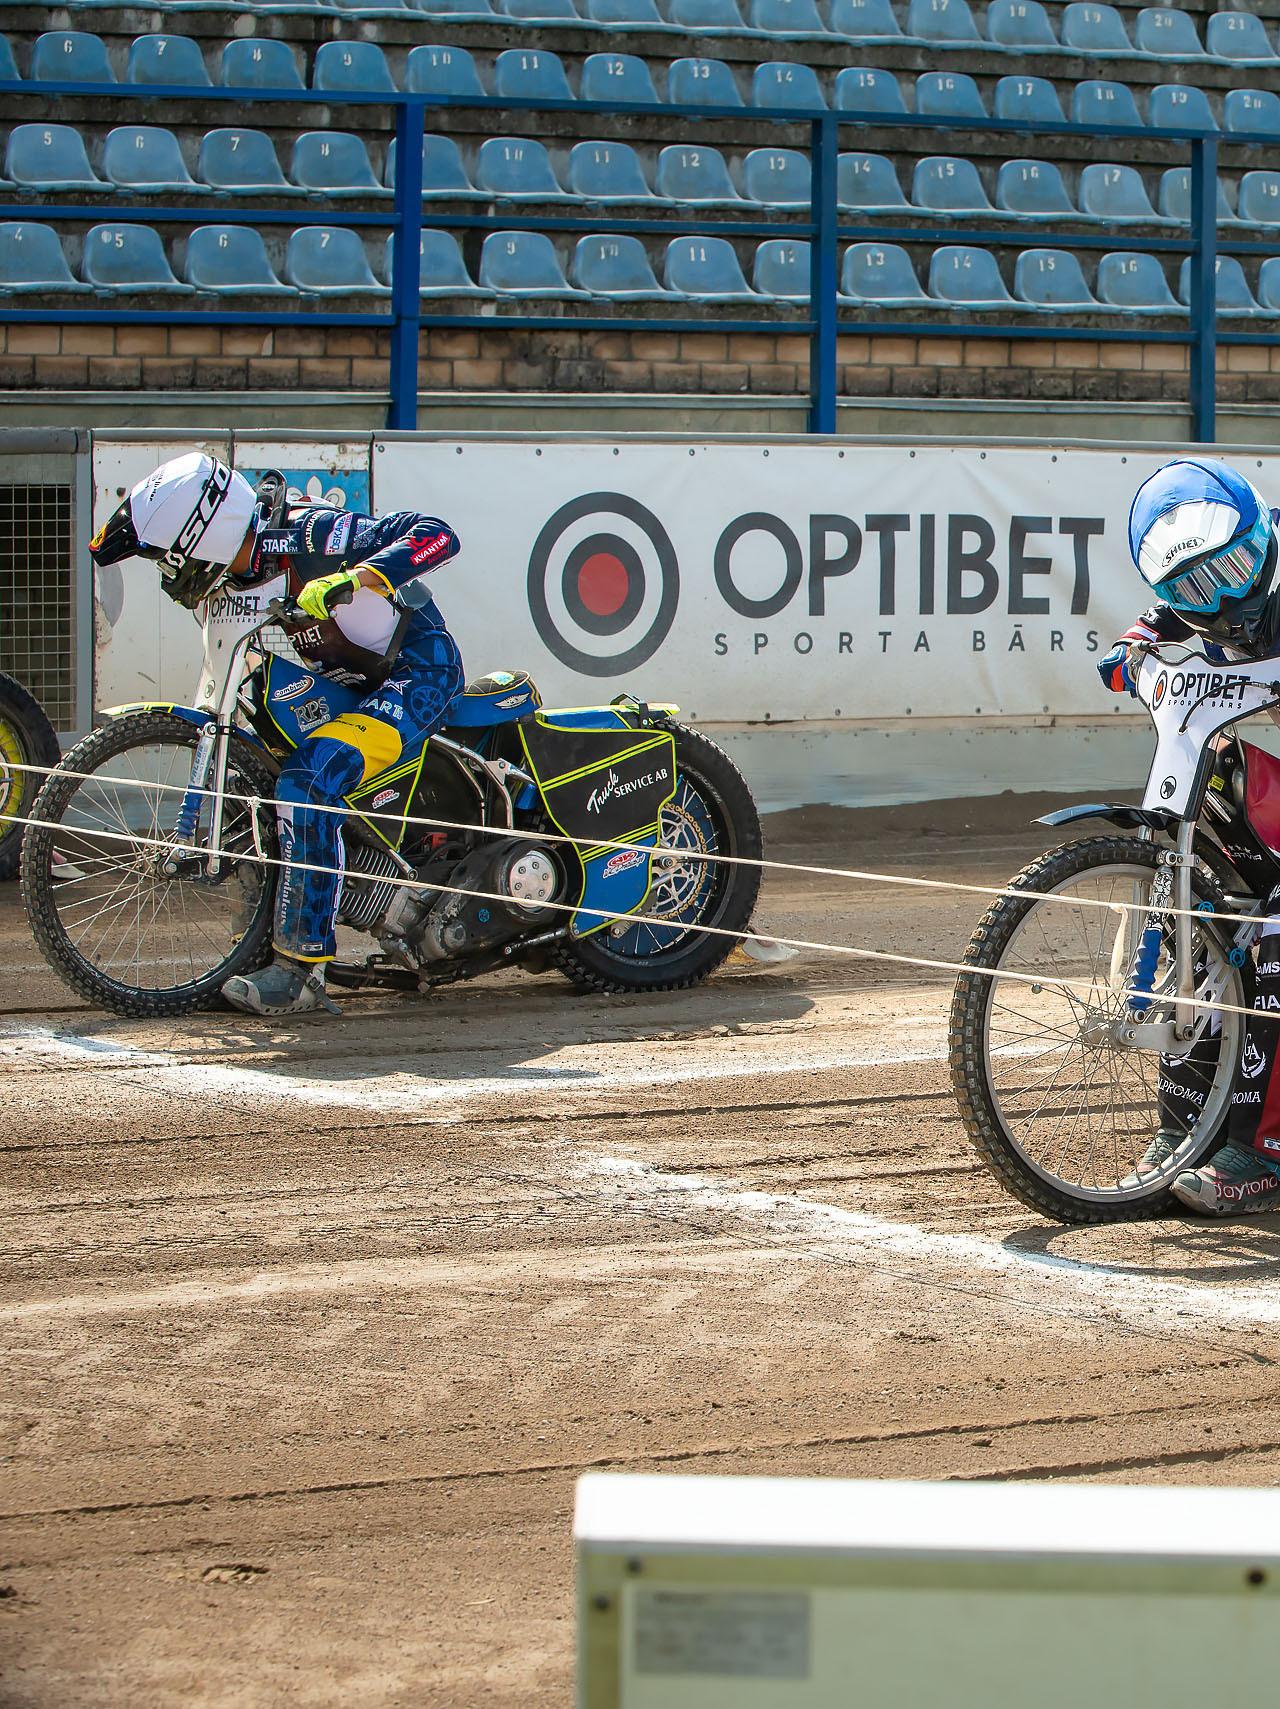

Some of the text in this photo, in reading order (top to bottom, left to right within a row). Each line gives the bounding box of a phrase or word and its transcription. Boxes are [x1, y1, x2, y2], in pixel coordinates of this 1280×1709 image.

[1227, 17, 1244, 29] 21
[157, 40, 166, 54] 7
[521, 55, 538, 69] 11
[607, 61, 624, 75] 12
[692, 65, 709, 78] 13
[776, 69, 792, 82] 14
[859, 72, 874, 86] 15
[1017, 82, 1032, 95] 17
[43, 130, 51, 144] 5
[230, 136, 239, 151] 7
[594, 150, 608, 163] 11
[681, 152, 699, 166] 12
[769, 156, 785, 169] 13
[853, 159, 870, 173] 14
[937, 162, 954, 178] 15
[1103, 168, 1120, 185] 17
[14, 226, 22, 240] 4
[114, 232, 123, 247] 5
[320, 232, 329, 247] 7
[690, 247, 705, 261] 11
[866, 251, 884, 266] 13
[953, 255, 970, 268] 14
[1039, 257, 1055, 271] 15
[262, 538, 289, 553] STAR
[413, 535, 449, 564] KVANTUM
[1165, 538, 1199, 564] SHOEI
[714, 511, 1105, 619] OPTIBET
[714, 623, 1099, 655] SPORTA BĀRS
[1170, 672, 1252, 700] OPTIBET
[586, 768, 668, 814] Truck SERVICE AB
